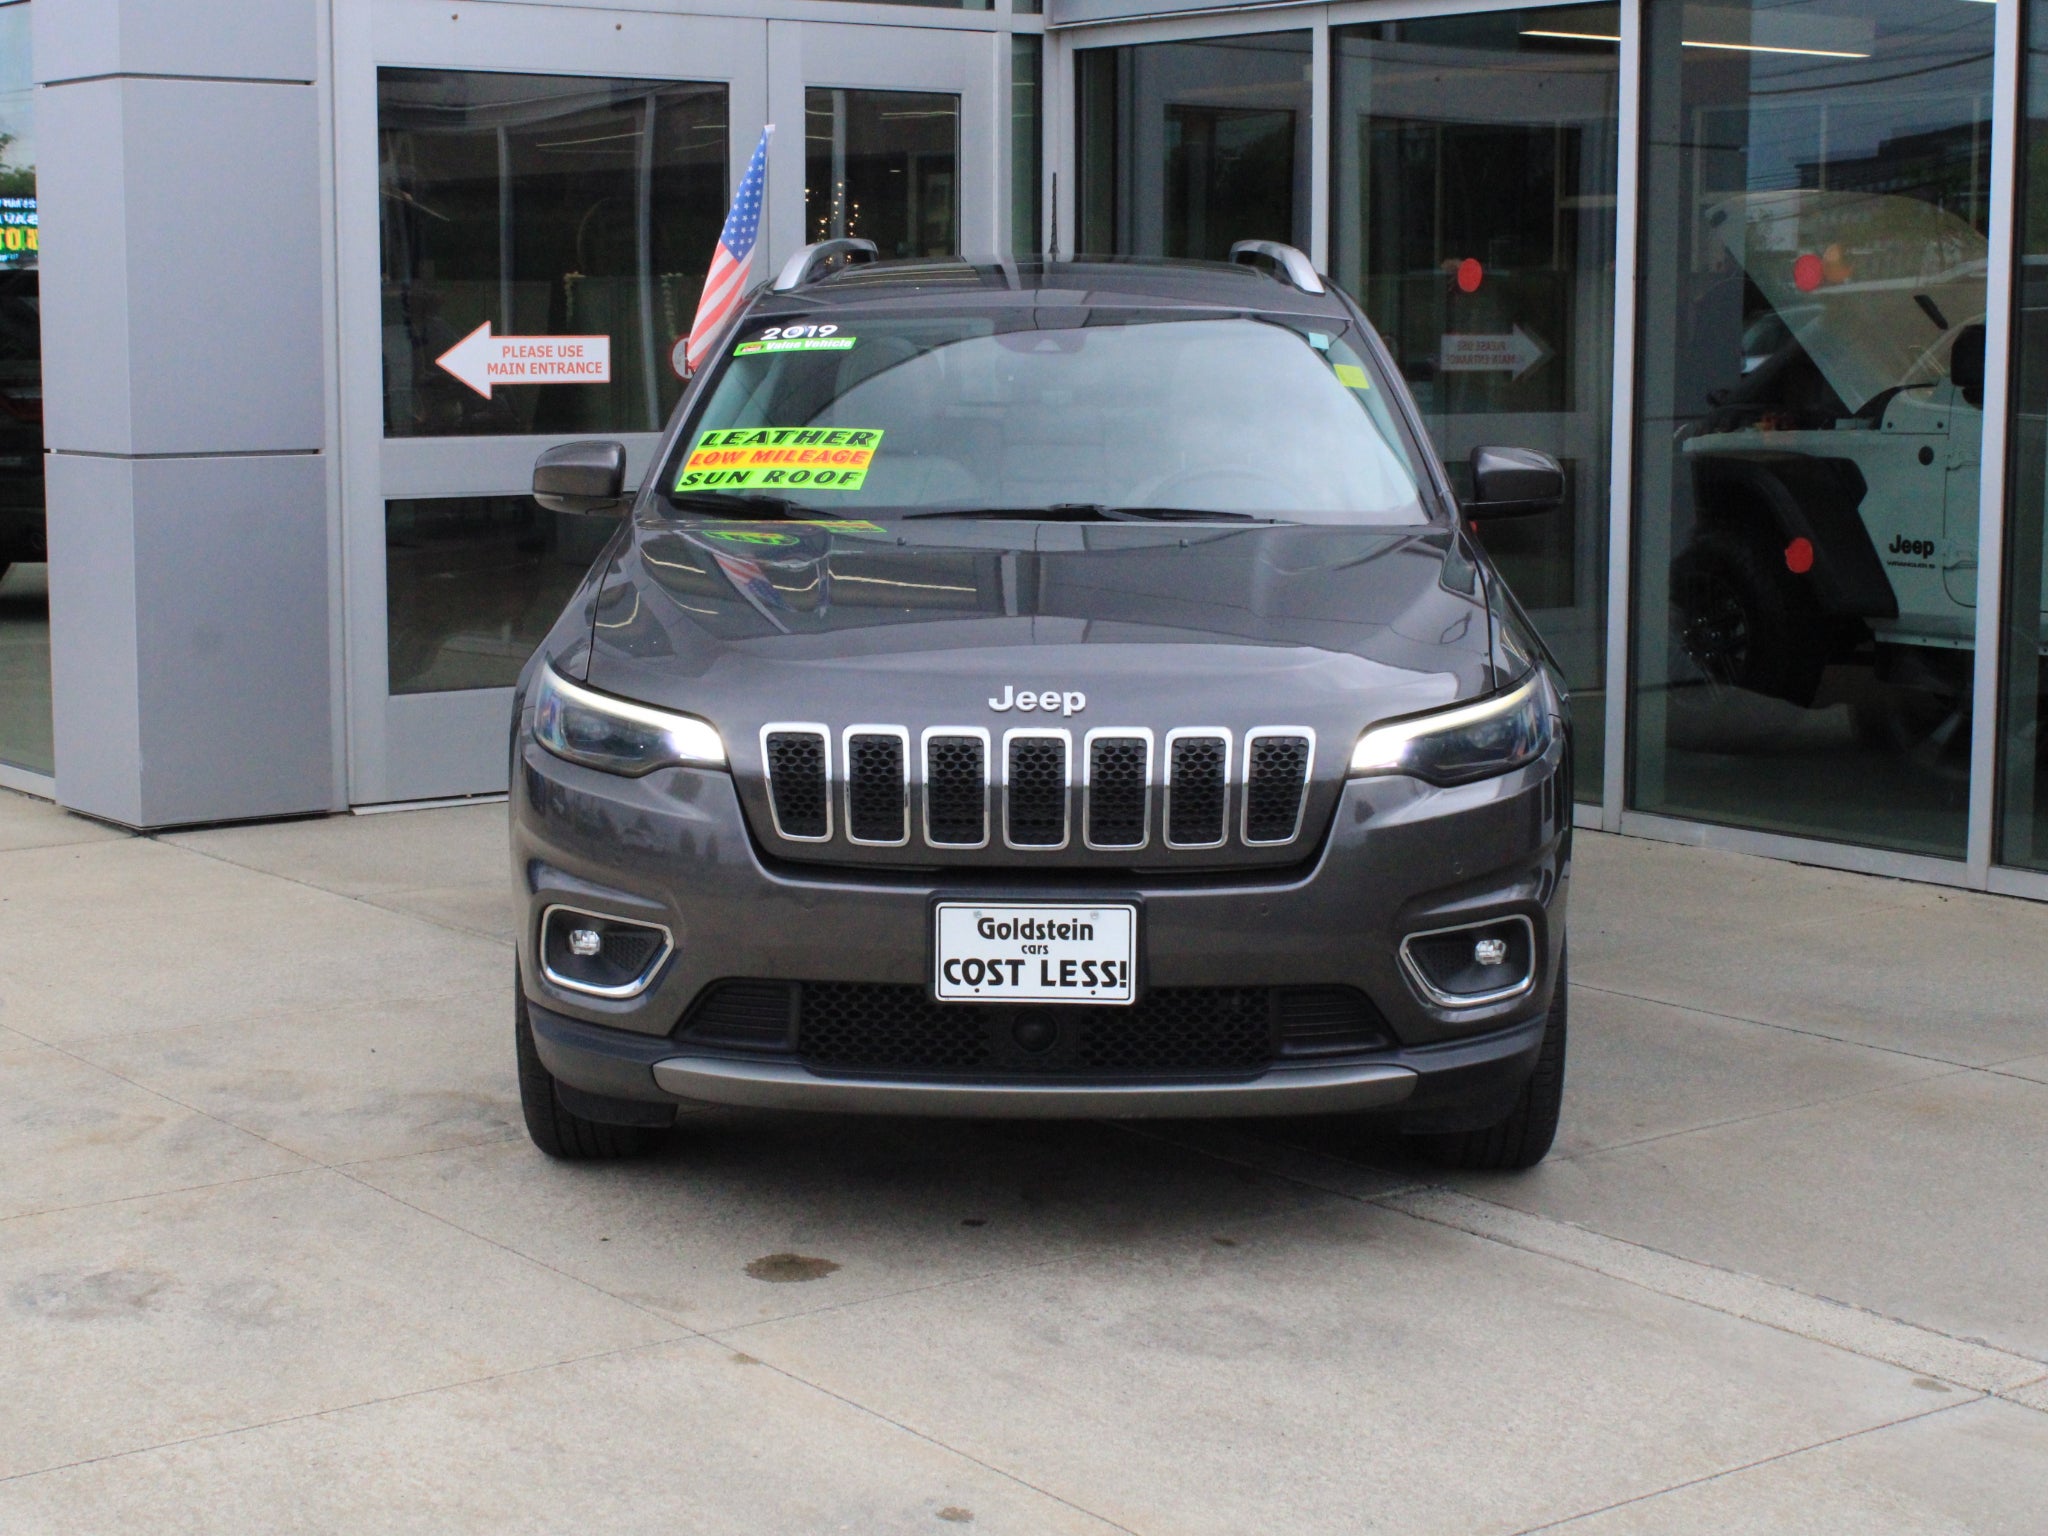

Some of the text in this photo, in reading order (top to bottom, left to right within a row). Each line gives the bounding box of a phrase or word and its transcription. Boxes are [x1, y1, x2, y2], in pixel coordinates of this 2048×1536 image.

[760, 324, 838, 341] 2019
[501, 345, 584, 358] PLEASE USE
[766, 340, 802, 351] Value
[804, 338, 853, 349] Vehicle
[486, 361, 603, 376] MAIN ENTRANCE
[701, 430, 877, 447] LEATHER
[689, 449, 869, 467] LOW MILEAGE
[681, 469, 864, 487] SUN ROOF
[1888, 534, 1935, 560] Jeep
[988, 685, 1086, 718] Jeep
[977, 916, 1094, 941] Goldstein
[1020, 944, 1049, 955] cars
[943, 957, 1127, 988] COST LESS!
